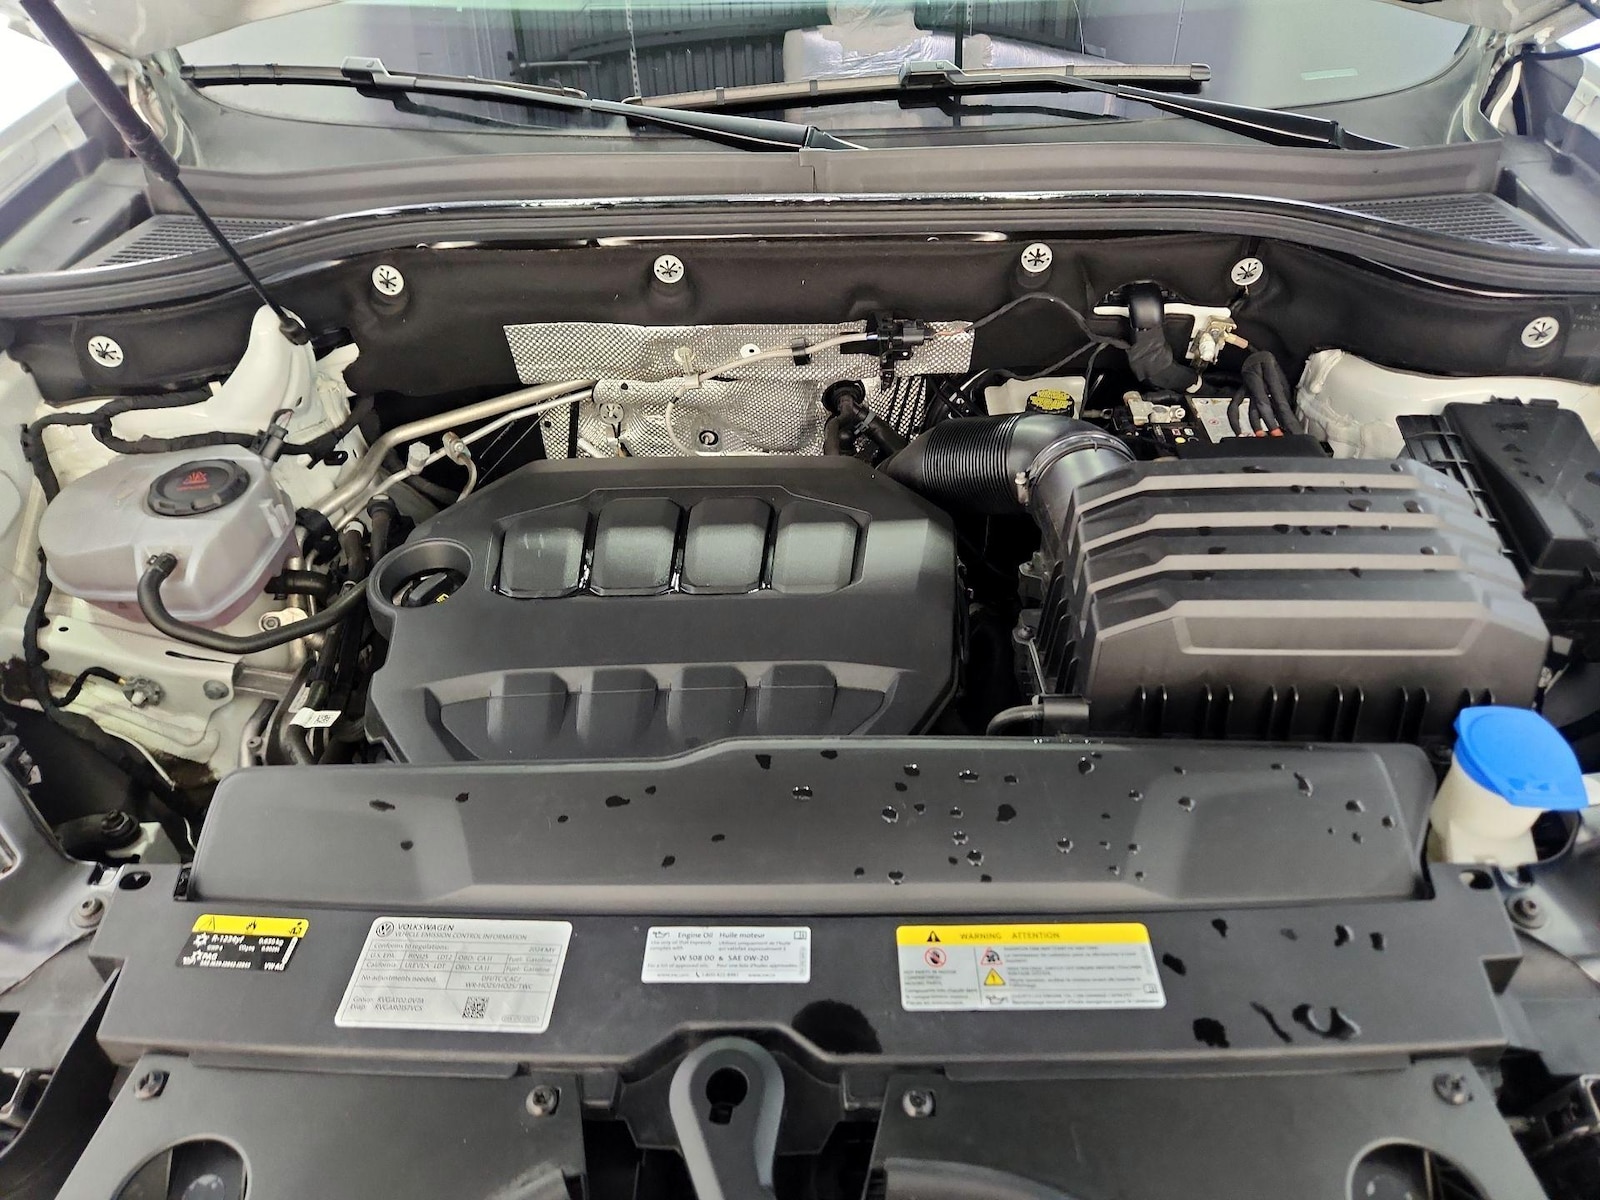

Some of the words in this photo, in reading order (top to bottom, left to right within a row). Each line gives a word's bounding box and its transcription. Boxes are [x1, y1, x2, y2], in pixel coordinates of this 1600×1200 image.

[398, 923, 455, 931] VOLKSWAGEN
[678, 932, 702, 940] Engine
[960, 931, 1003, 940] WARNING
[1011, 931, 1061, 939] ATTENTION
